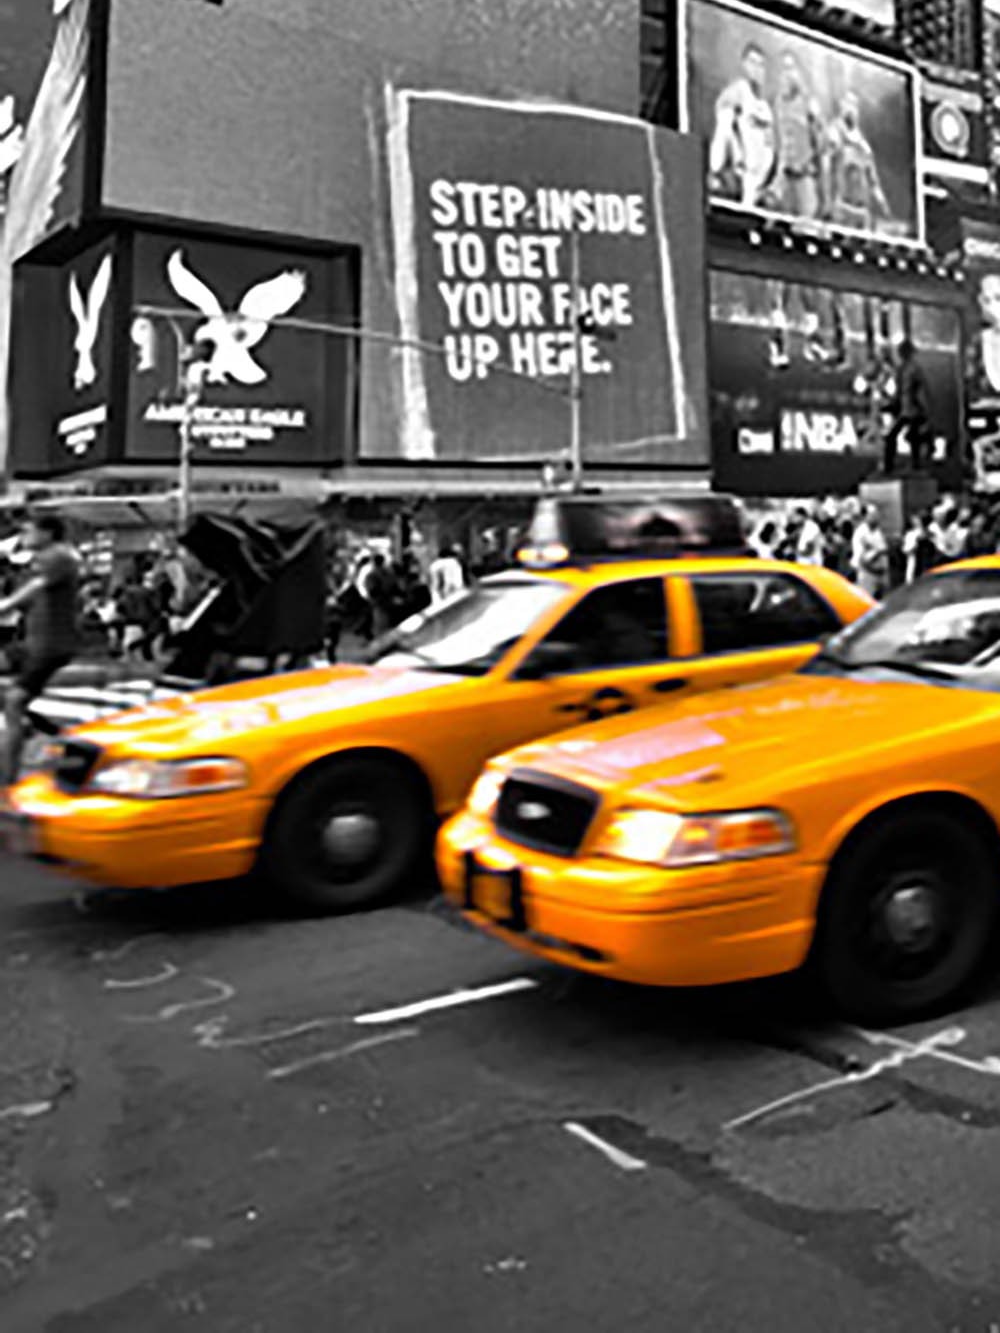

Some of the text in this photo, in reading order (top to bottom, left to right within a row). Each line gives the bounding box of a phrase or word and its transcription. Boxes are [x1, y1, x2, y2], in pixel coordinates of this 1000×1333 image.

[430, 179, 646, 235] STEP INSIDE
[432, 231, 562, 279] TO GET
[438, 281, 545, 328] YOUR
[443, 333, 499, 381] UP
[144, 403, 246, 424] AMEICAN
